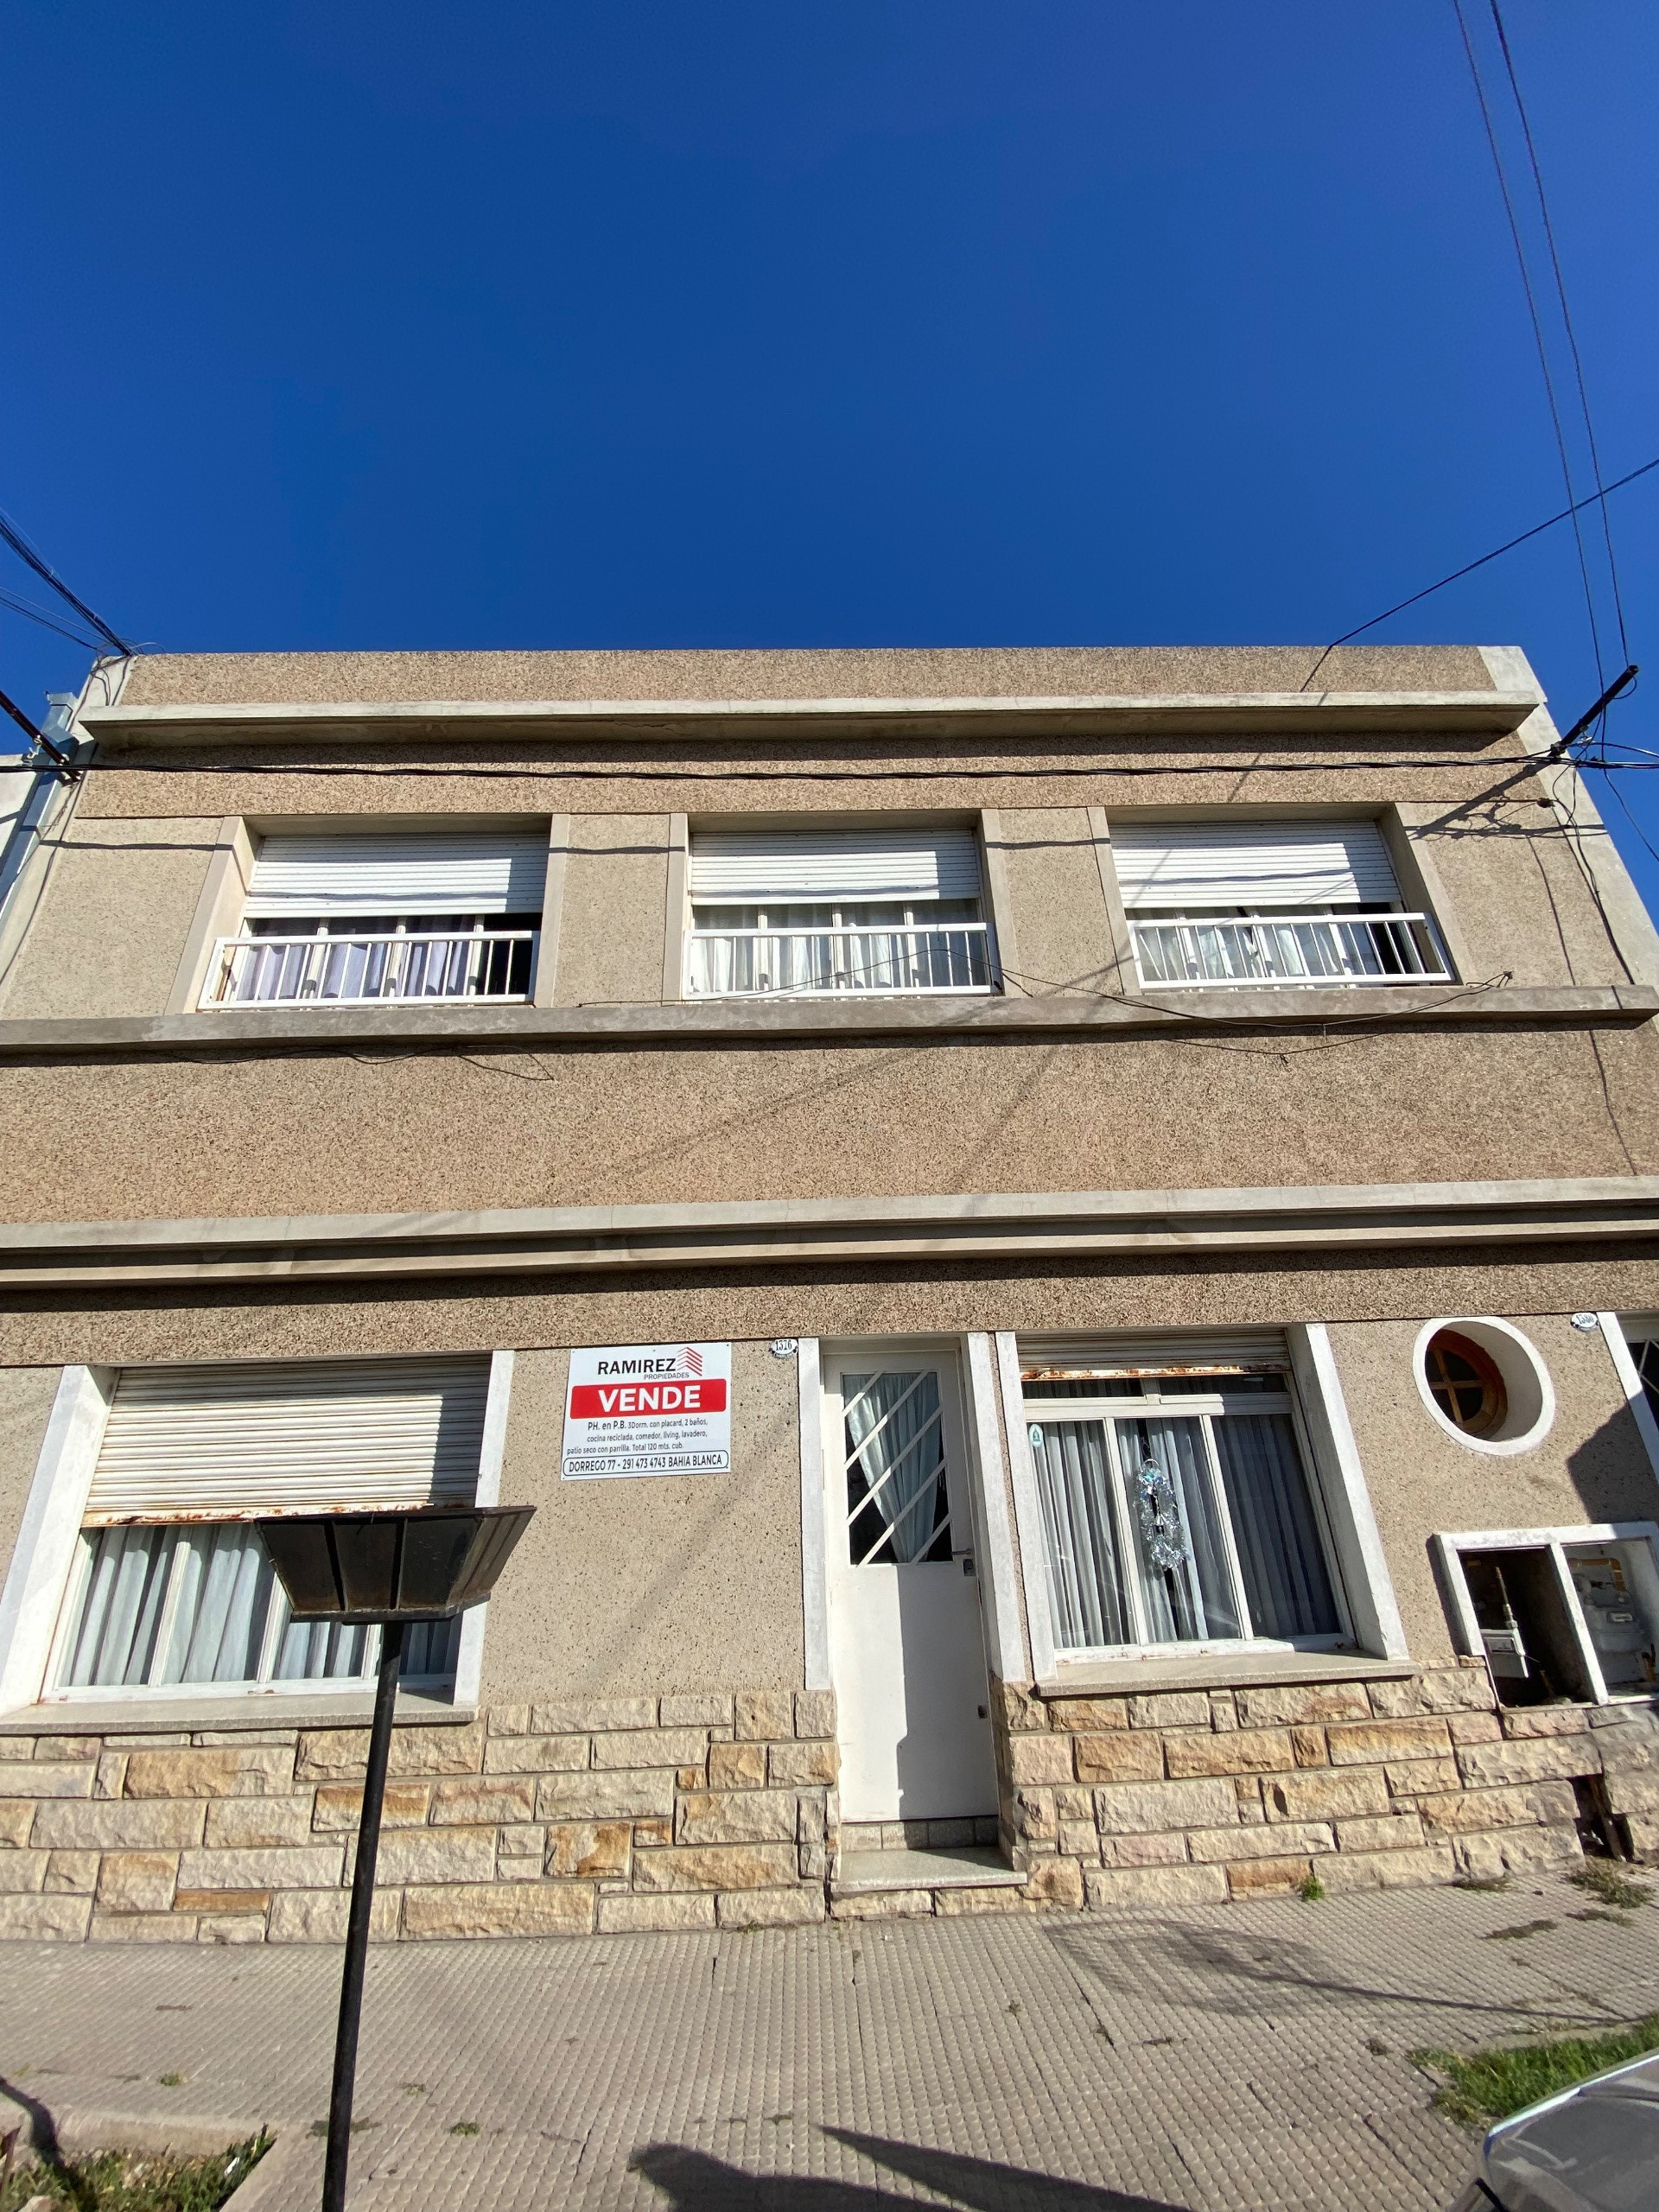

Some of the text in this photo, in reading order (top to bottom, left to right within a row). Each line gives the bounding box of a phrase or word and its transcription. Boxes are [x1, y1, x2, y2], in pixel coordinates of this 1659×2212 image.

[775, 1339, 792, 1351] 1376
[598, 1358, 676, 1375] RAMIREZ
[598, 1385, 701, 1412] VENDE
[588, 1421, 600, 1431] PH.
[613, 1421, 626, 1429] P.B.
[661, 1419, 683, 1428] placard,
[636, 1432, 662, 1440] comedor,
[664, 1431, 681, 1440] living,
[567, 1446, 582, 1456] patio
[609, 1445, 631, 1453] parrilla.
[569, 1460, 606, 1472] DORREGO
[607, 1459, 616, 1471] 77
[622, 1459, 634, 1470] 291
[635, 1458, 648, 1469] 473
[650, 1457, 666, 1468] 4743
[668, 1456, 691, 1467] BAHIA
[692, 1454, 722, 1466] BLANCA
